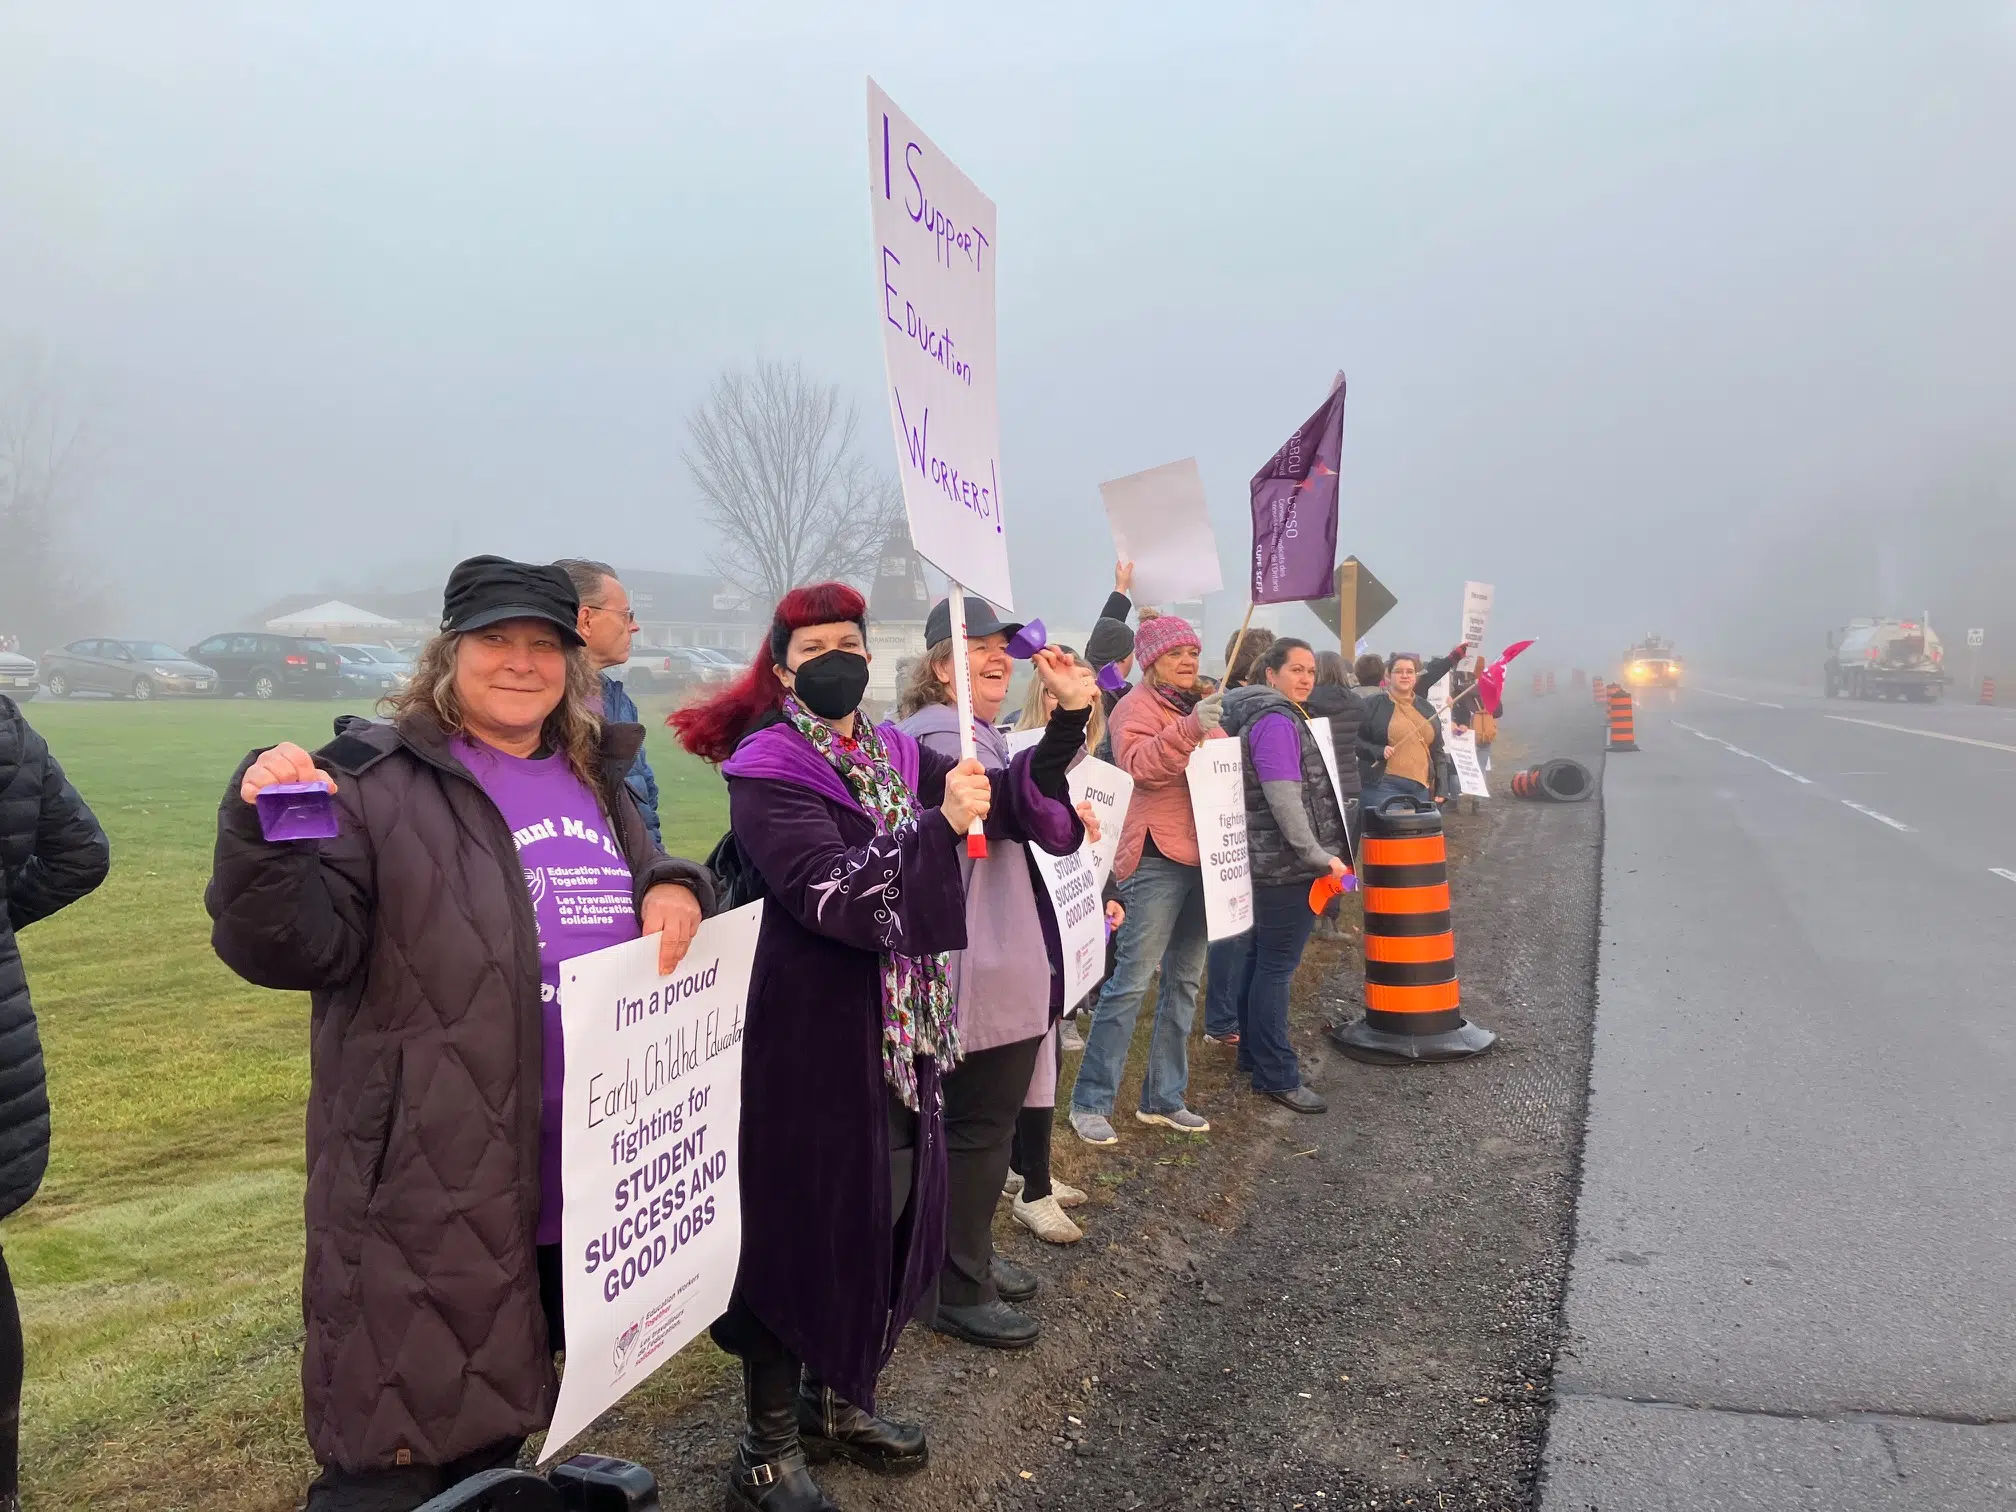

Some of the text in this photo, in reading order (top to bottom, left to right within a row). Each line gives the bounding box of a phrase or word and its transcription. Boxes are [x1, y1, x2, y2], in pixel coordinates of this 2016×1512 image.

[883, 112, 890, 200] I
[1213, 761, 1231, 774] I'm
[1232, 762, 1238, 772] a
[1085, 786, 1115, 807] proud
[560, 816, 599, 844] Me
[546, 866, 601, 876] Education
[550, 876, 598, 887] Together
[1054, 851, 1083, 880] STUDENT
[1220, 865, 1242, 882] GOOD
[555, 896, 576, 905] Les
[1055, 869, 1095, 908] SUCCESS AND
[558, 905, 574, 915] de
[560, 915, 614, 925] solidaires
[1065, 893, 1096, 929] GOOD JOBS
[616, 958, 719, 1031] I'm a proud
[588, 1058, 638, 1128] Early
[611, 1084, 711, 1166] fighting for
[614, 1124, 708, 1212] STUDENT
[584, 1150, 727, 1274] SUCCESS AND
[604, 1195, 716, 1303] GOOD JOBS
[645, 1273, 700, 1321] Education Workers
